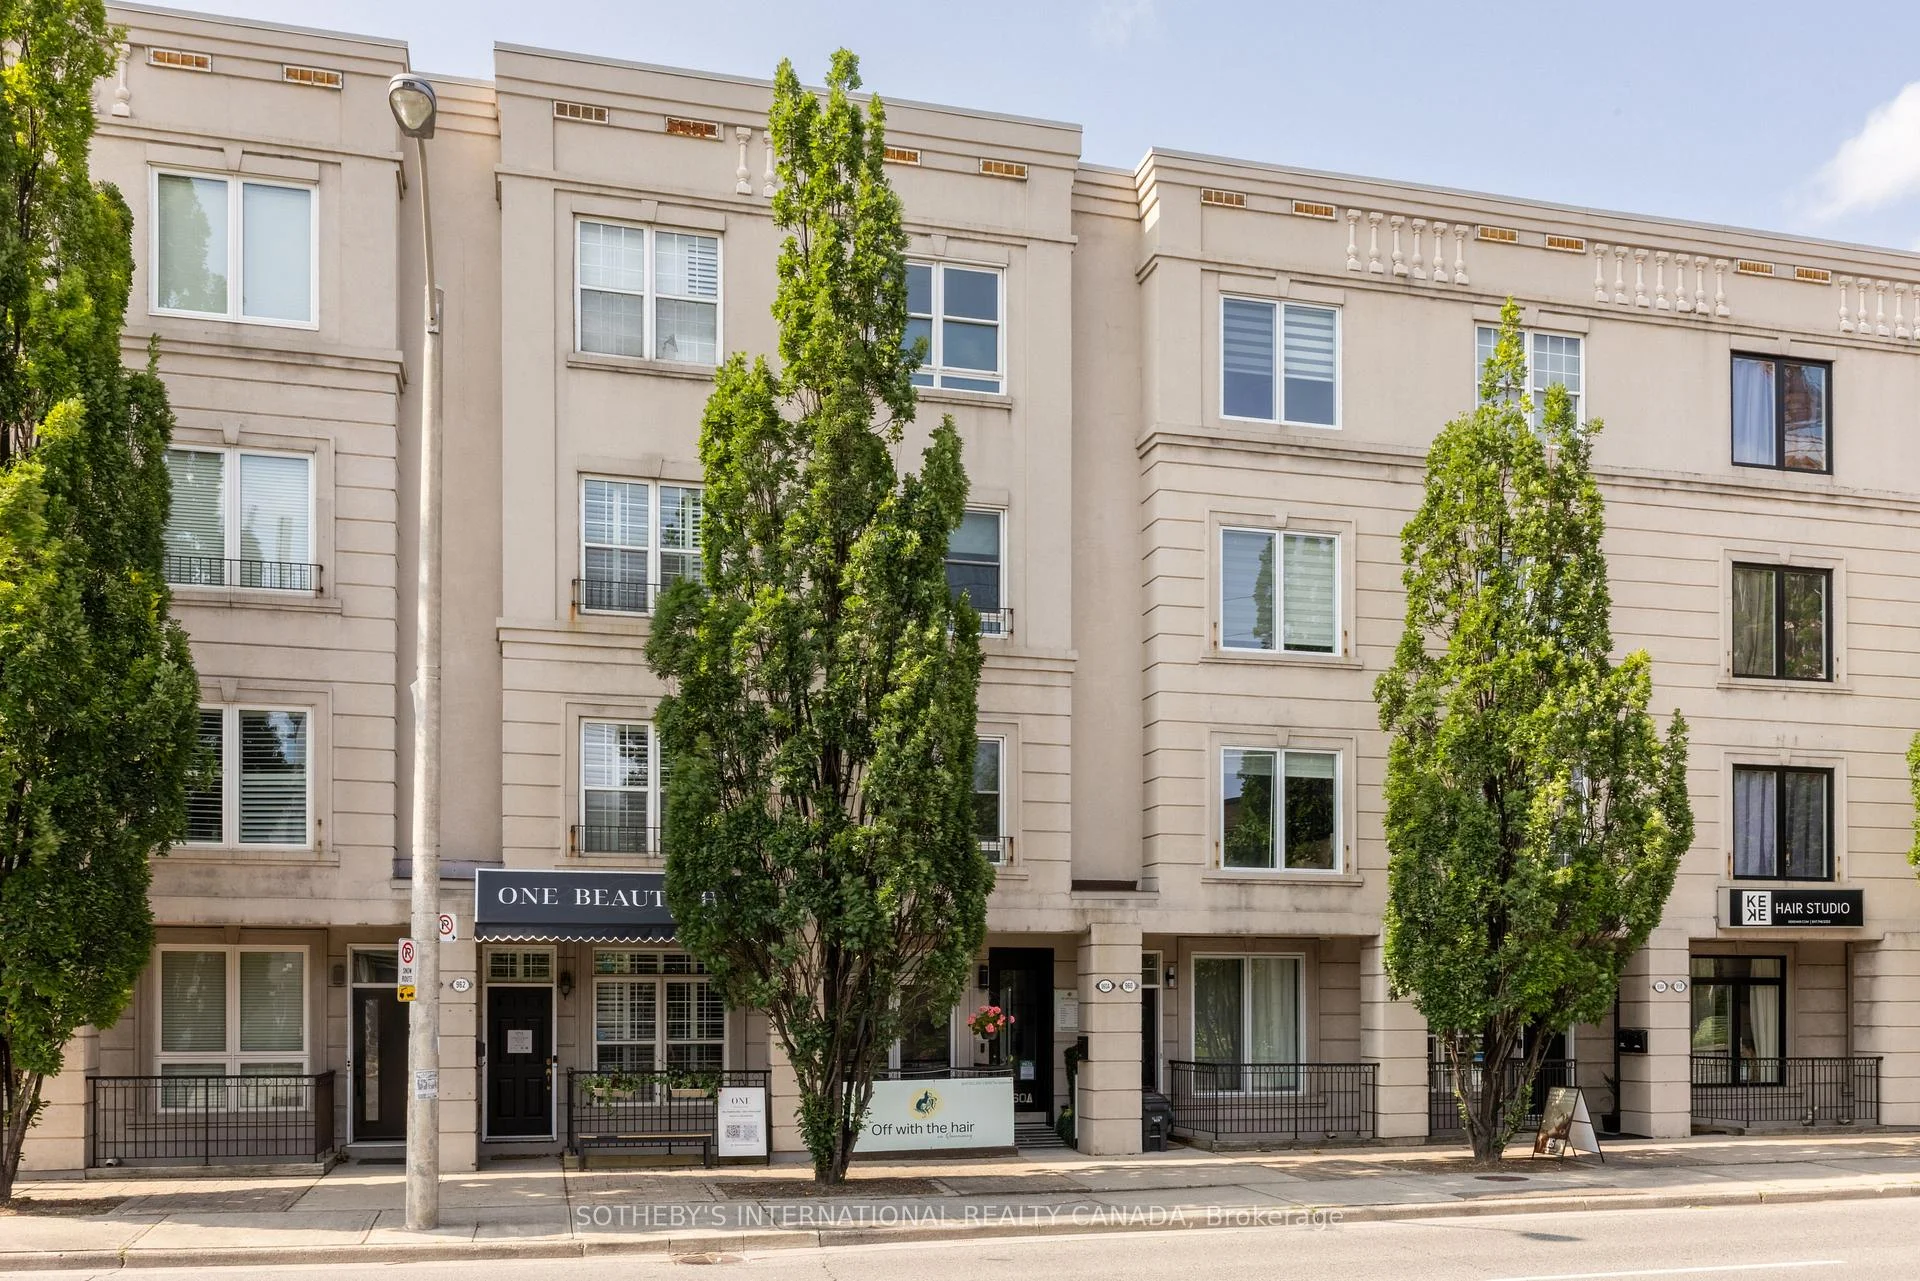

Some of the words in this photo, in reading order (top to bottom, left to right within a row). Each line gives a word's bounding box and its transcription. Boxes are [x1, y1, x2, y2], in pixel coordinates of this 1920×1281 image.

[498, 887, 558, 905] ONE
[575, 888, 670, 907] BEAUT
[1746, 895, 1767, 908] KE
[1775, 902, 1803, 914] HAIR
[1806, 902, 1850, 914] STUDIO
[1013, 1092, 1033, 1103] 60A
[871, 1123, 893, 1136] Off
[896, 1122, 923, 1136] with
[926, 1122, 948, 1134] the
[951, 1121, 975, 1133] hair
